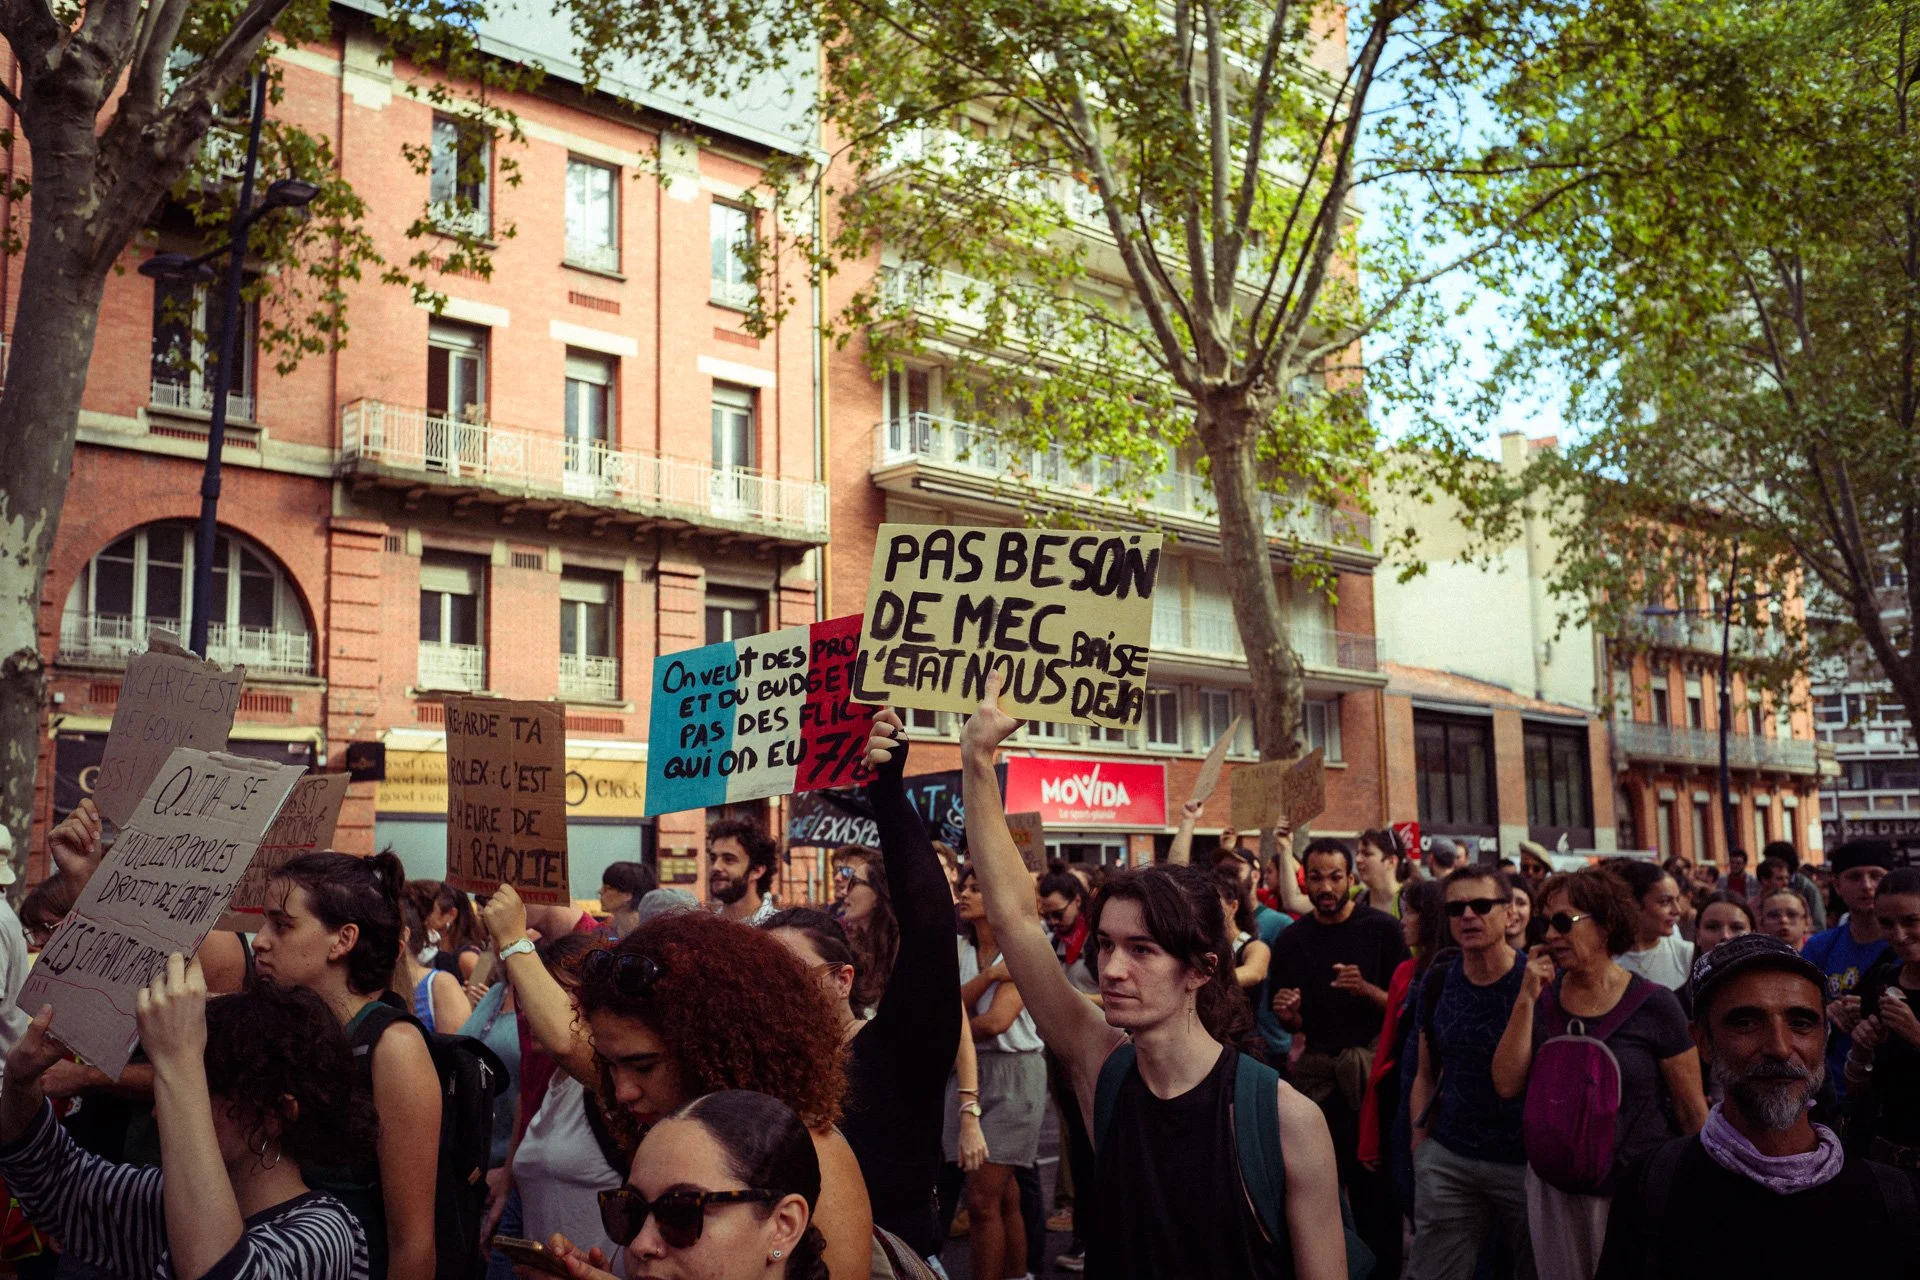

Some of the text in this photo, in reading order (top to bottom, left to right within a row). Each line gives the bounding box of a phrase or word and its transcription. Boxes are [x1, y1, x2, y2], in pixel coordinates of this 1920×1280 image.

[884, 528, 986, 582] PAS
[869, 590, 1066, 654] DE MEC
[762, 646, 808, 671] DES
[812, 632, 861, 664] PRO
[199, 678, 238, 714] EST
[680, 661, 858, 719] ET DU BUDGET
[962, 651, 1070, 705] NOUS
[1071, 677, 1144, 726] DEJA
[448, 706, 543, 745] REGARDE TA
[680, 721, 725, 749] PAS
[738, 707, 789, 736] DES
[767, 738, 808, 769] EU
[230, 776, 268, 811] SE
[501, 761, 553, 793] C'EST
[1041, 763, 1132, 809] MOVIDA
[450, 793, 541, 837] L'HEURE DE
[449, 837, 464, 877] LA
[41, 921, 96, 977] LES
